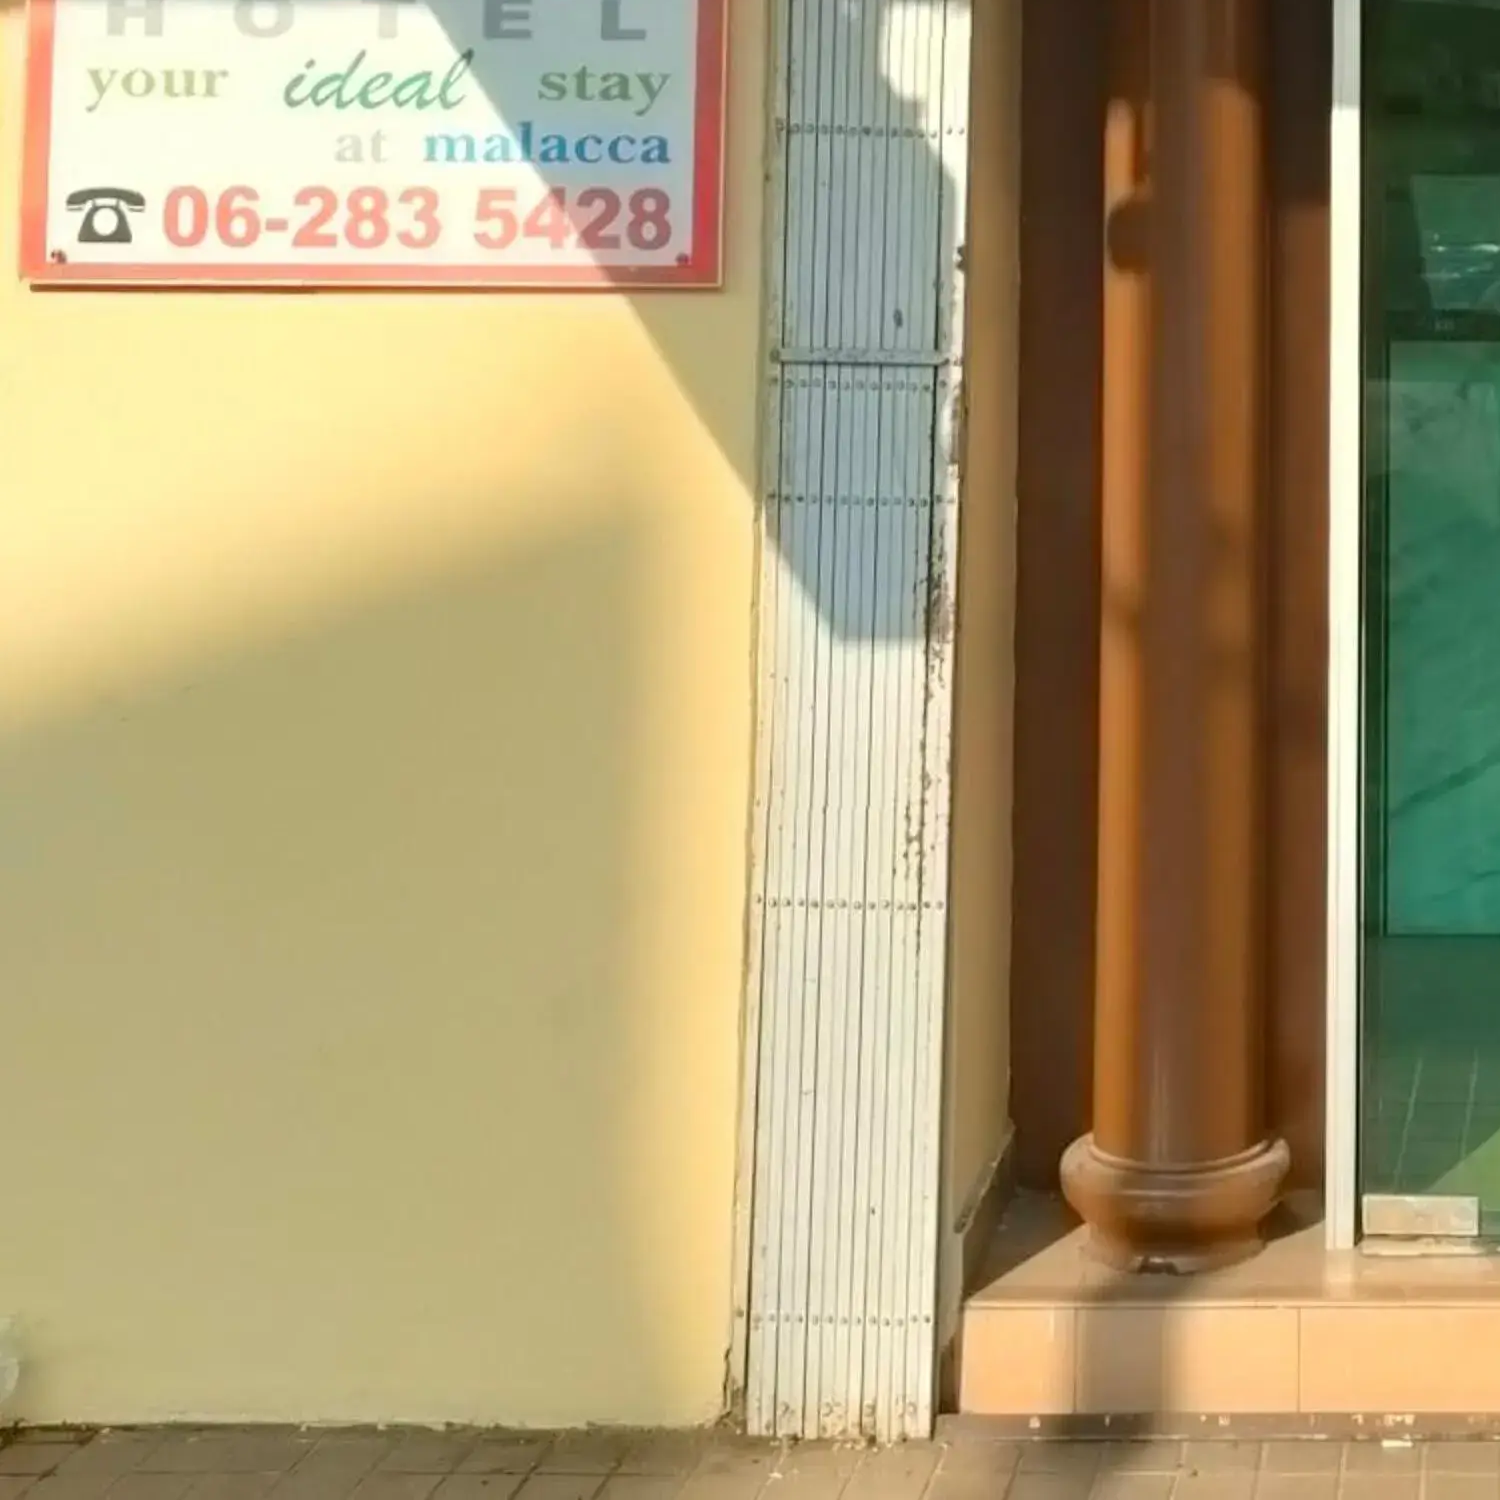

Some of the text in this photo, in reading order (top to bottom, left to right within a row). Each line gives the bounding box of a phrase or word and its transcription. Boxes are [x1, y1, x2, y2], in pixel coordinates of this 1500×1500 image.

[86, 49, 671, 116] your ideal stay
[334, 122, 671, 165] at malacca
[162, 185, 672, 251] 06-283 5428
